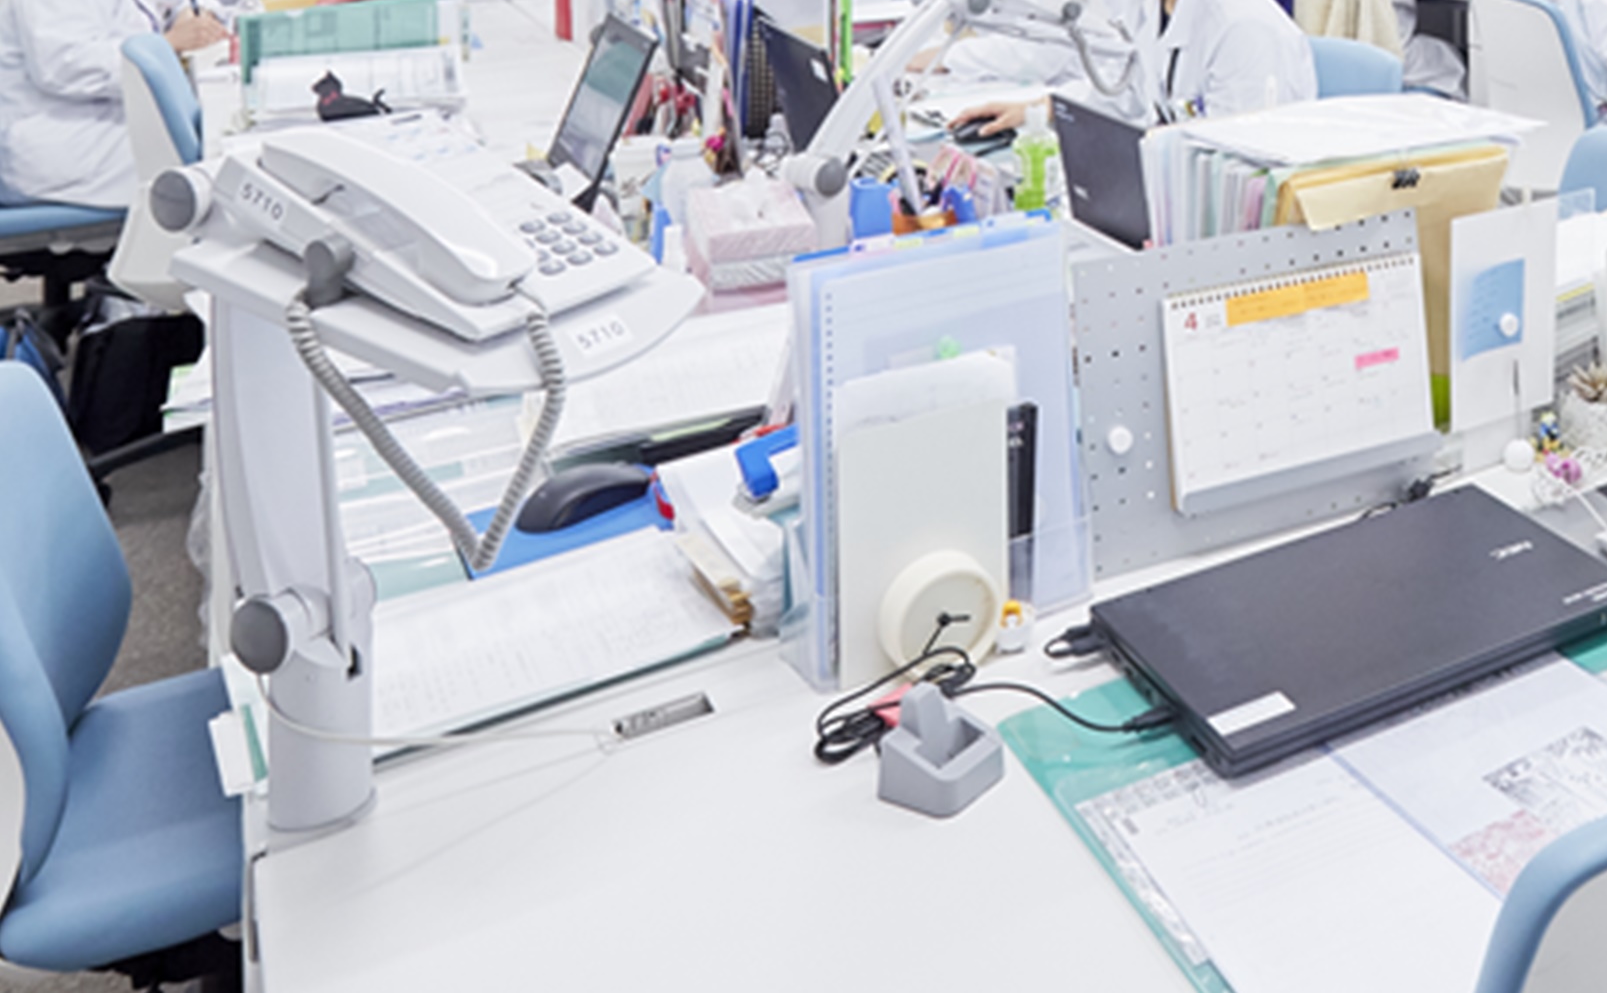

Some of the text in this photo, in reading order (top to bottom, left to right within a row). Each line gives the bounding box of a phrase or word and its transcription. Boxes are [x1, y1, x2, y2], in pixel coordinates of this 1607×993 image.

[242, 182, 284, 220] 5710
[576, 320, 625, 349] 5710
[1184, 312, 1198, 330] 4
